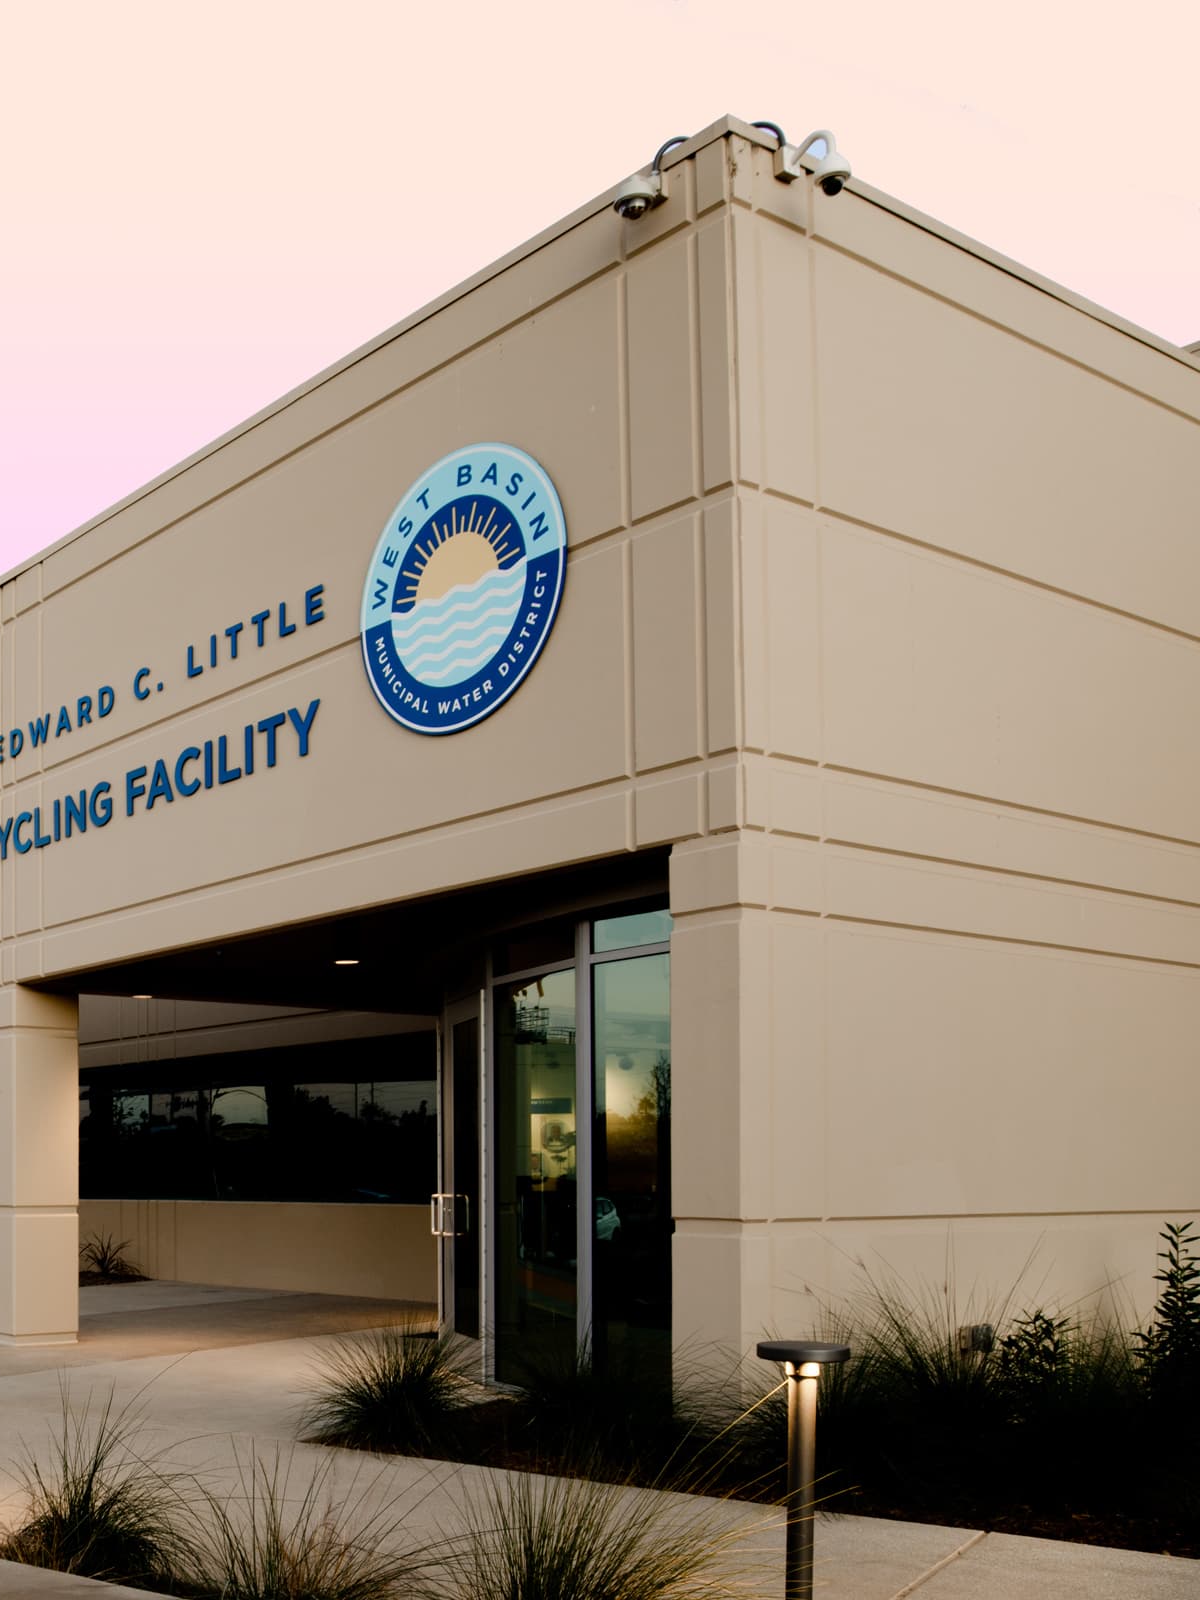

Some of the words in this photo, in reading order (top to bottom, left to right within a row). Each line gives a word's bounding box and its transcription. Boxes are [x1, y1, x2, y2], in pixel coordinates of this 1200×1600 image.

[371, 487, 431, 610] WEST
[456, 462, 550, 541] BASIN
[133, 667, 164, 701] C.
[186, 584, 325, 679] LITTLE
[374, 635, 430, 715] MUNICIPAL
[438, 679, 494, 715] WATER
[498, 569, 548, 677] DISTRICT
[125, 698, 321, 817] FACILITY
